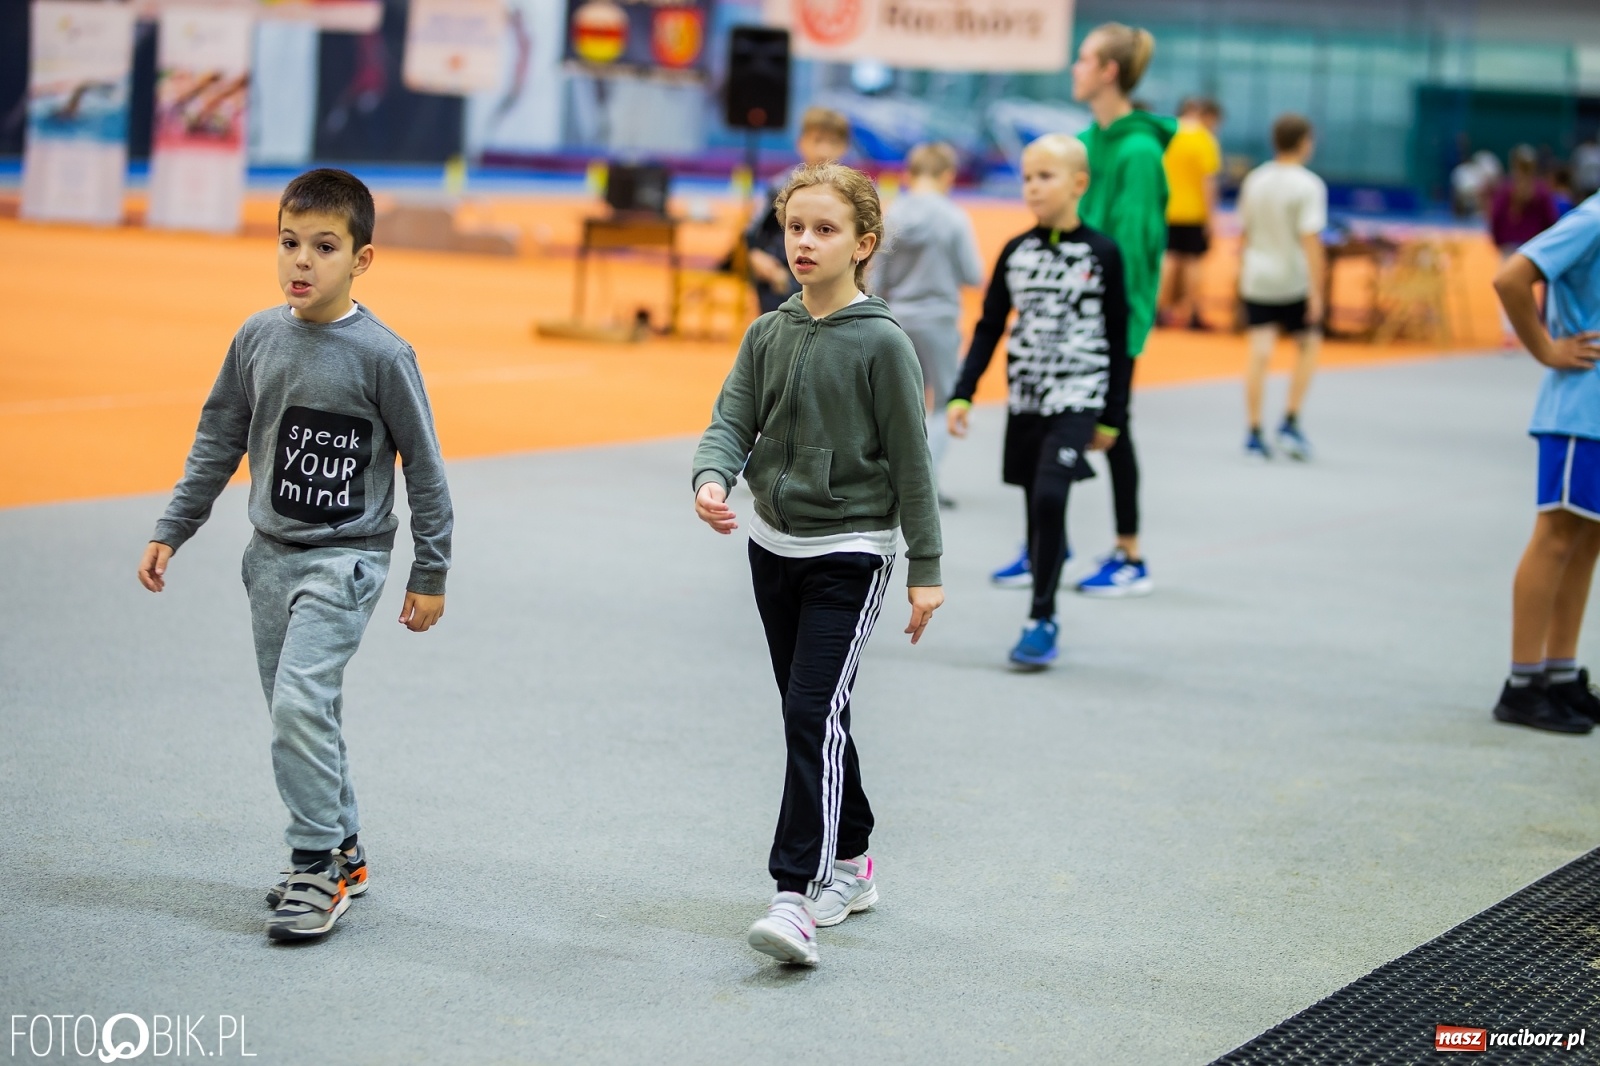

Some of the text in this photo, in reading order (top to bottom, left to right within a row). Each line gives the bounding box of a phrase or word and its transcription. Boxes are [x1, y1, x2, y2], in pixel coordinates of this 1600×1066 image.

[288, 425, 360, 450] speak
[284, 446, 357, 481] YOUR
[279, 478, 350, 507] mind
